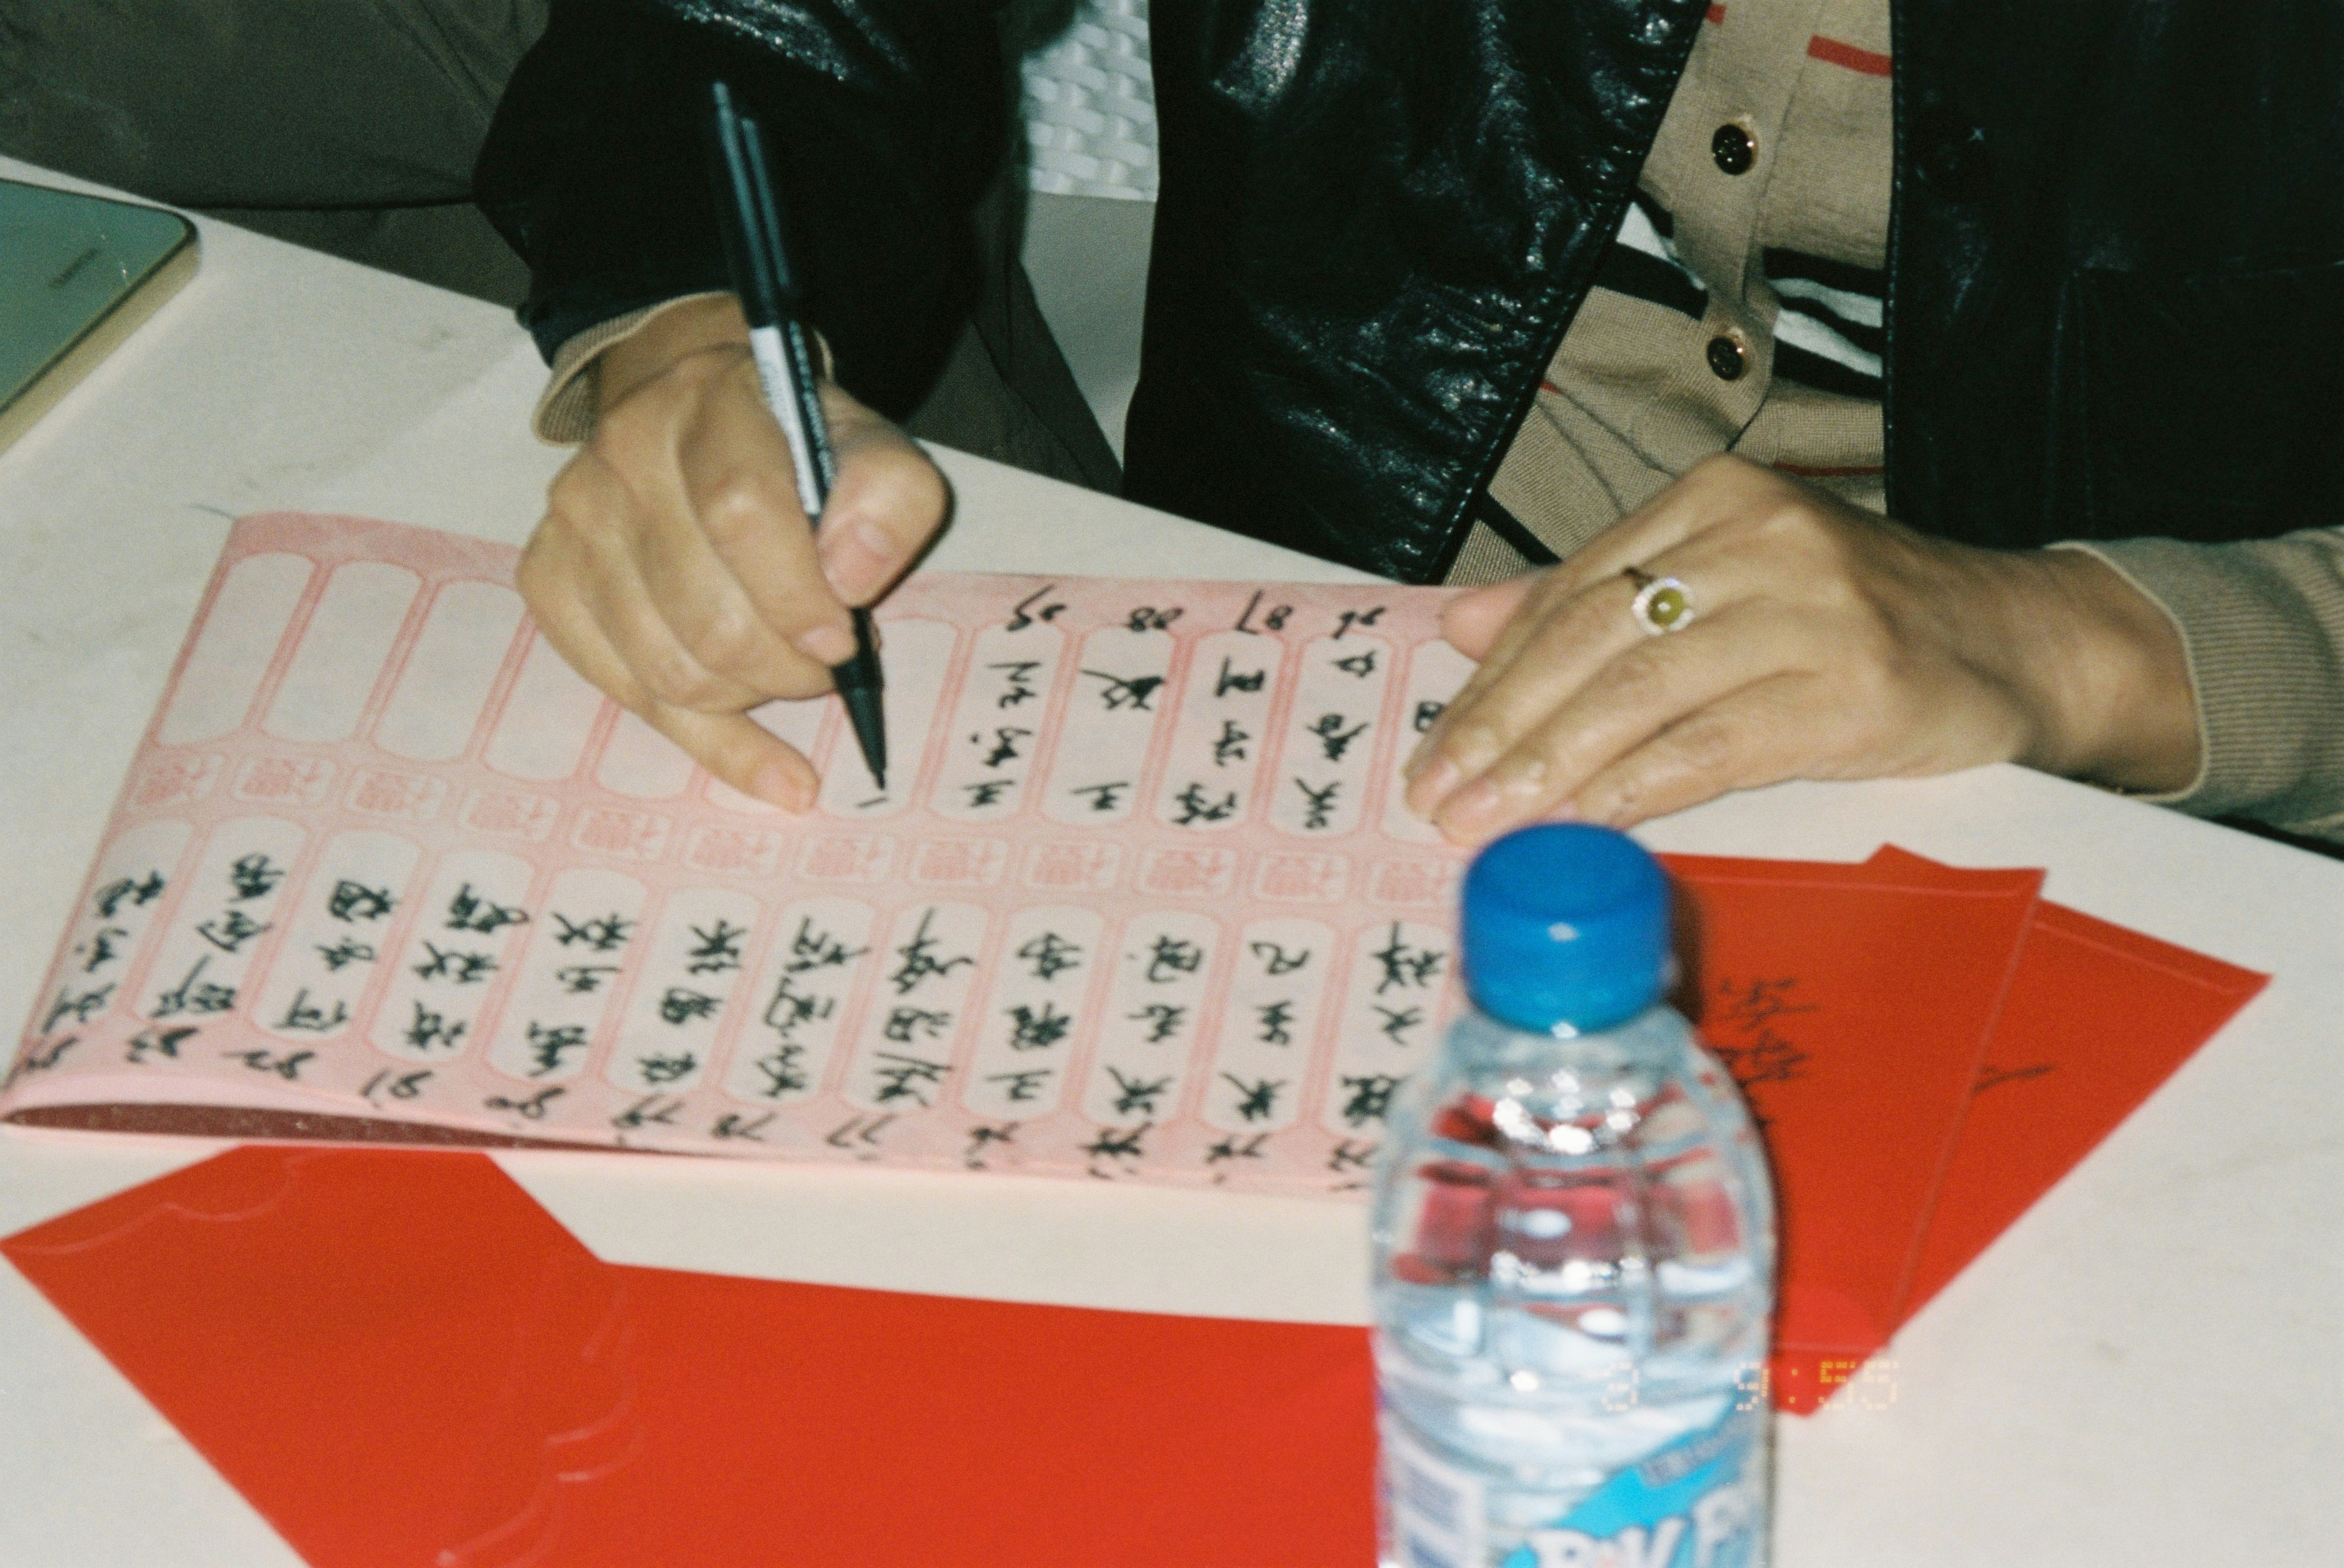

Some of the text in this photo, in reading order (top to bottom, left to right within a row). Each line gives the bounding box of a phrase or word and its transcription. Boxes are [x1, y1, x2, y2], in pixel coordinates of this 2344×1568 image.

[1125, 607, 1184, 633] 88
[1235, 590, 1293, 635] 87
[826, 1115, 898, 1148] 77
